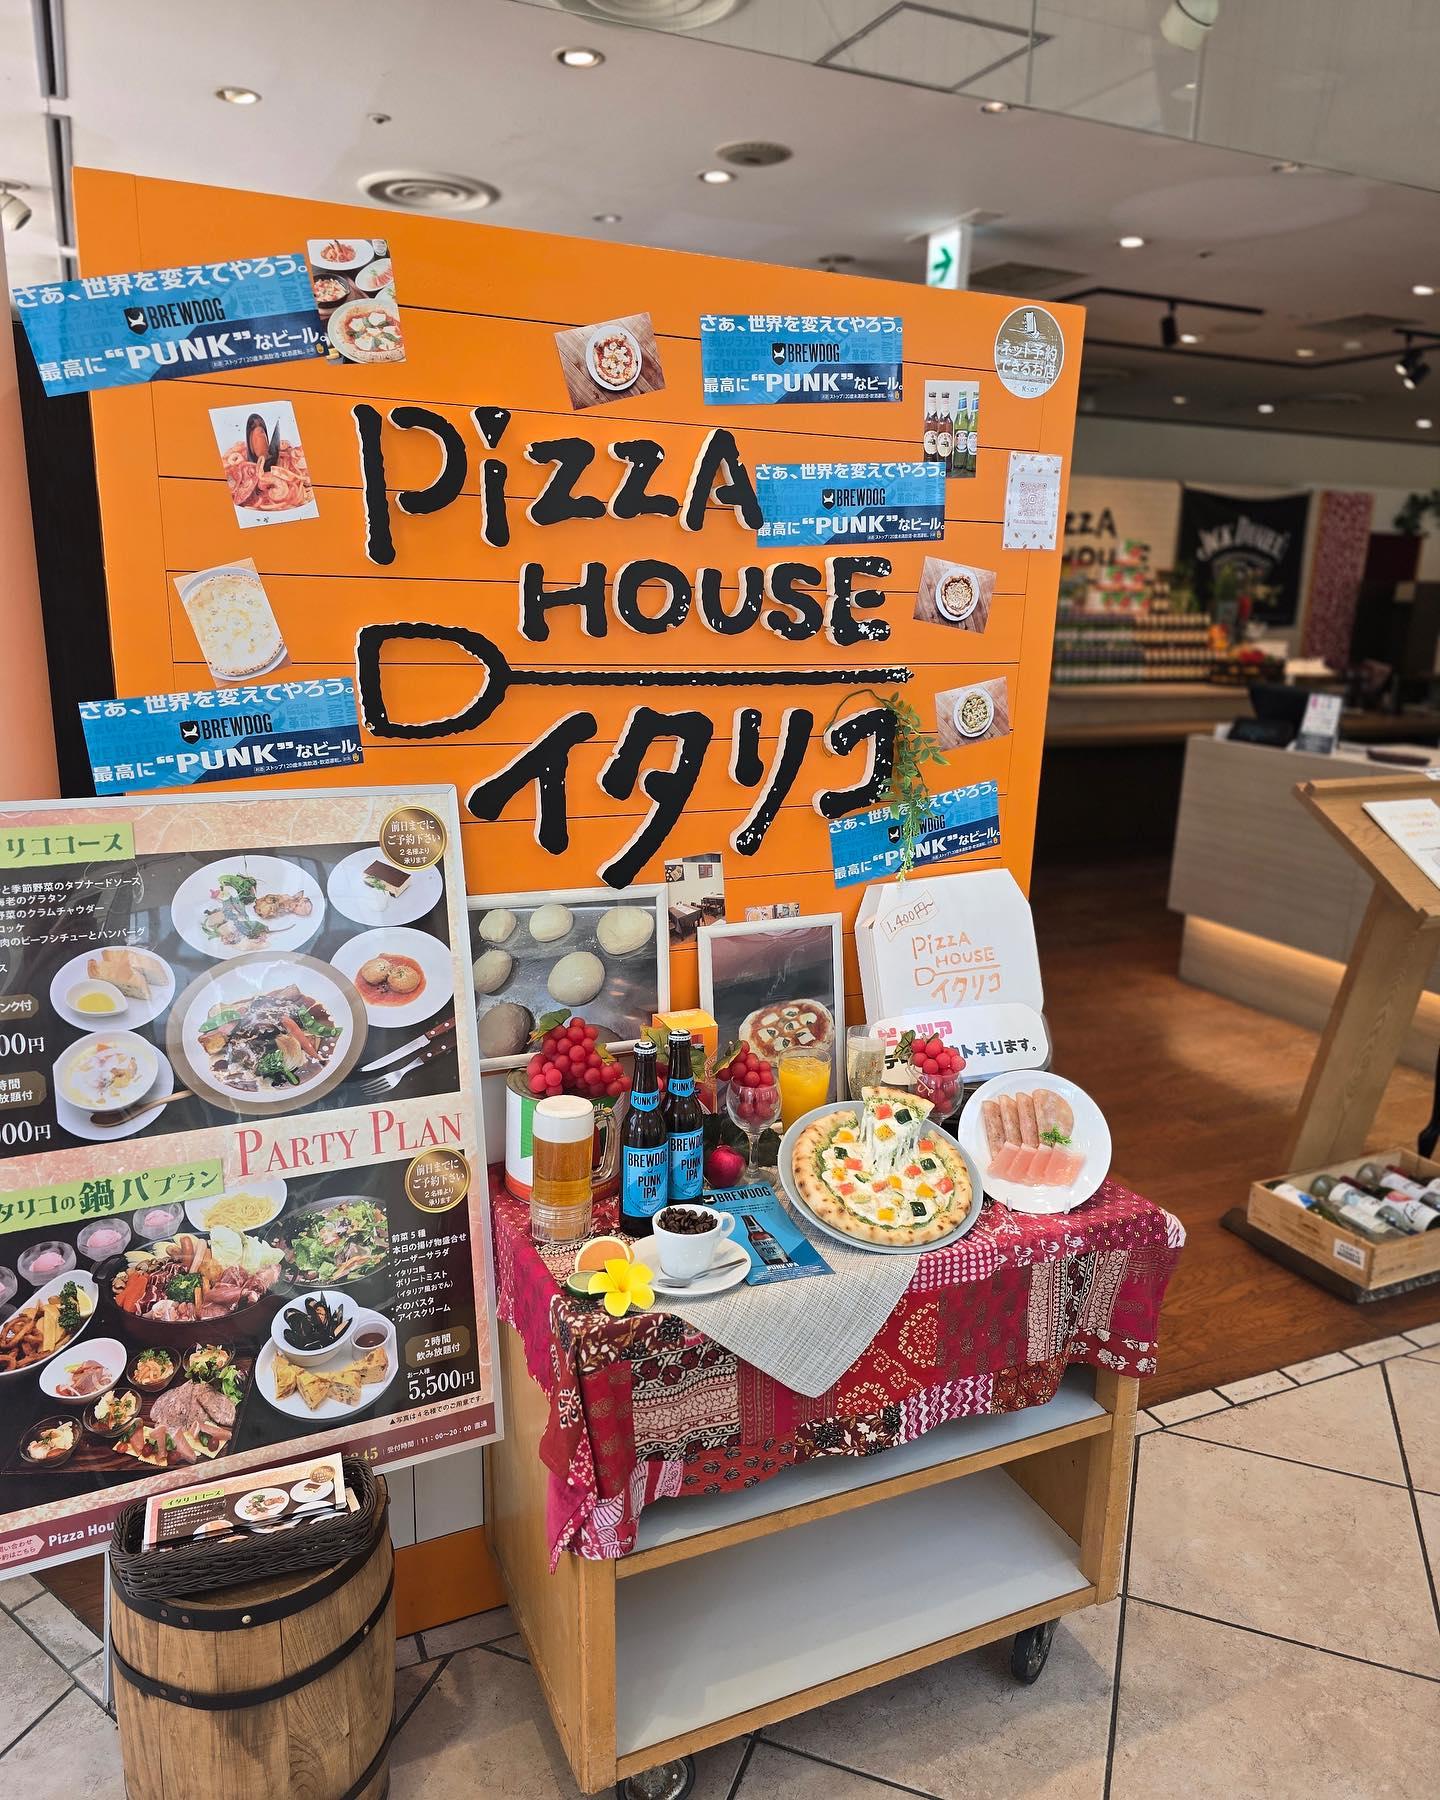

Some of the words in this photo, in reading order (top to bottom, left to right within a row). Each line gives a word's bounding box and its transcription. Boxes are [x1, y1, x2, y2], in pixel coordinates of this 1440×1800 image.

[13, 255, 309, 309] さあ、世界を変えてやろう。
[148, 298, 226, 330] BREWDOG
[700, 315, 903, 333] さあ、世界を変えてやろう。
[788, 344, 840, 363] BREWDOG
[756, 463, 946, 481] さあ、世界を変えてやろう。
[836, 489, 886, 507] BREWDOG
[518, 556, 893, 647] HOUSE
[80, 680, 354, 720] さあ、世界を変えてやろう。
[202, 714, 273, 740] BREWDOG
[464, 705, 901, 891] イタリコ
[391, 820, 435, 832] 前日までに
[7, 833, 123, 858] リココース
[388, 833, 440, 846] ご予約下さい
[403, 857, 428, 865] 承ります
[936, 947, 995, 968] HOUSE
[931, 972, 1001, 1003] イタリコ
[672, 1080, 690, 1092] PUNK
[633, 1094, 651, 1106] PUNK
[0, 1120, 52, 1145] 00円
[234, 1125, 359, 1178] PARTY
[368, 1107, 463, 1156] PLAN
[416, 1159, 459, 1177] 前日までに
[681, 1157, 701, 1170] PUNK
[413, 1172, 465, 1189] ご予約下さい
[638, 1175, 661, 1188] PUNK
[686, 1169, 698, 1181] IPA
[643, 1187, 657, 1199] IPA
[716, 1186, 771, 1203] BREWDOG
[394, 1248, 450, 1267] シーザーサラダ
[394, 1265, 426, 1278] イタリコ風
[397, 1304, 451, 1323] アイスクリーム
[416, 1343, 460, 1362] 飲み放題付
[408, 1370, 475, 1400] 5,500円
[48, 1530, 85, 1547] Pizza
[0, 1546, 36, 1561] 約はこちら
